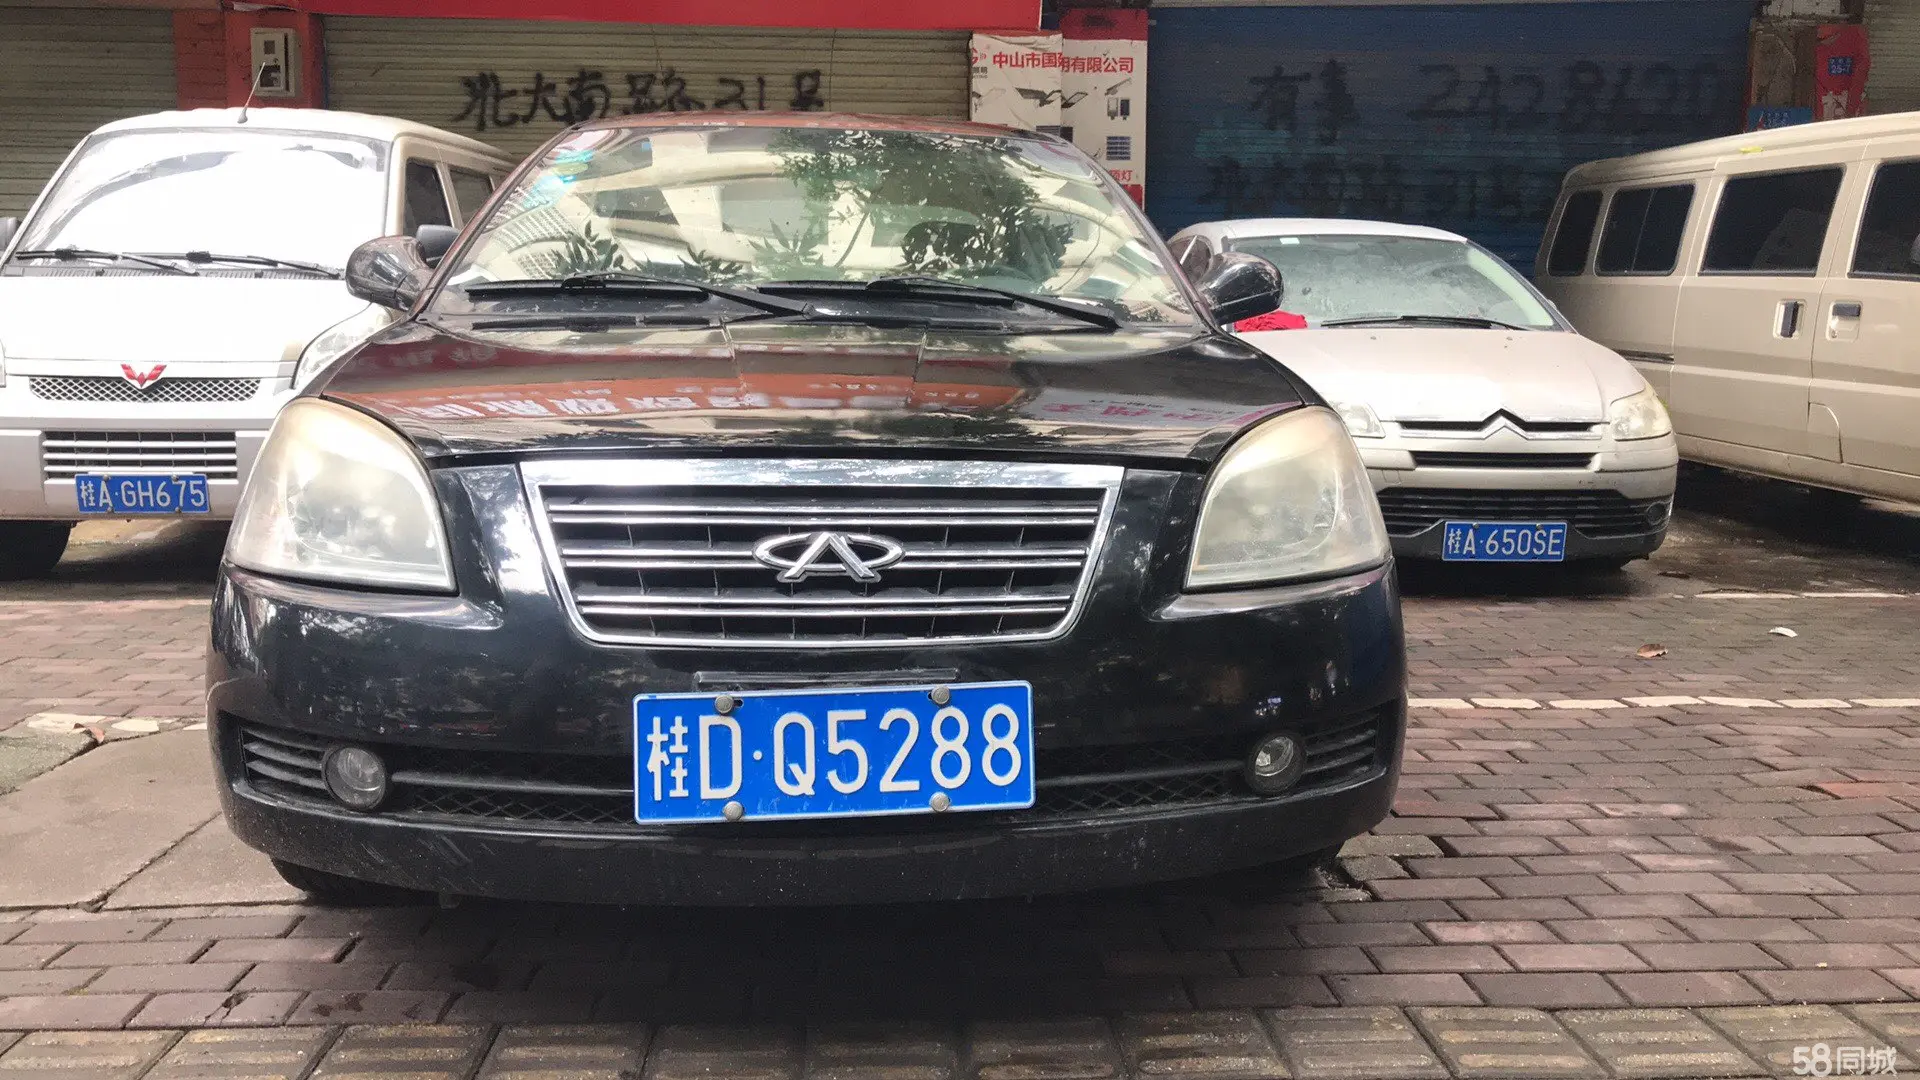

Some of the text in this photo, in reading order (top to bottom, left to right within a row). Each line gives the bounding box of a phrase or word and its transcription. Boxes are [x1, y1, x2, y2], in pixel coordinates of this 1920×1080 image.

[79, 479, 205, 508] 桂A·GH675
[1448, 528, 1564, 556] 桂A·650SE
[646, 702, 1022, 801] 桂D·Q5288
